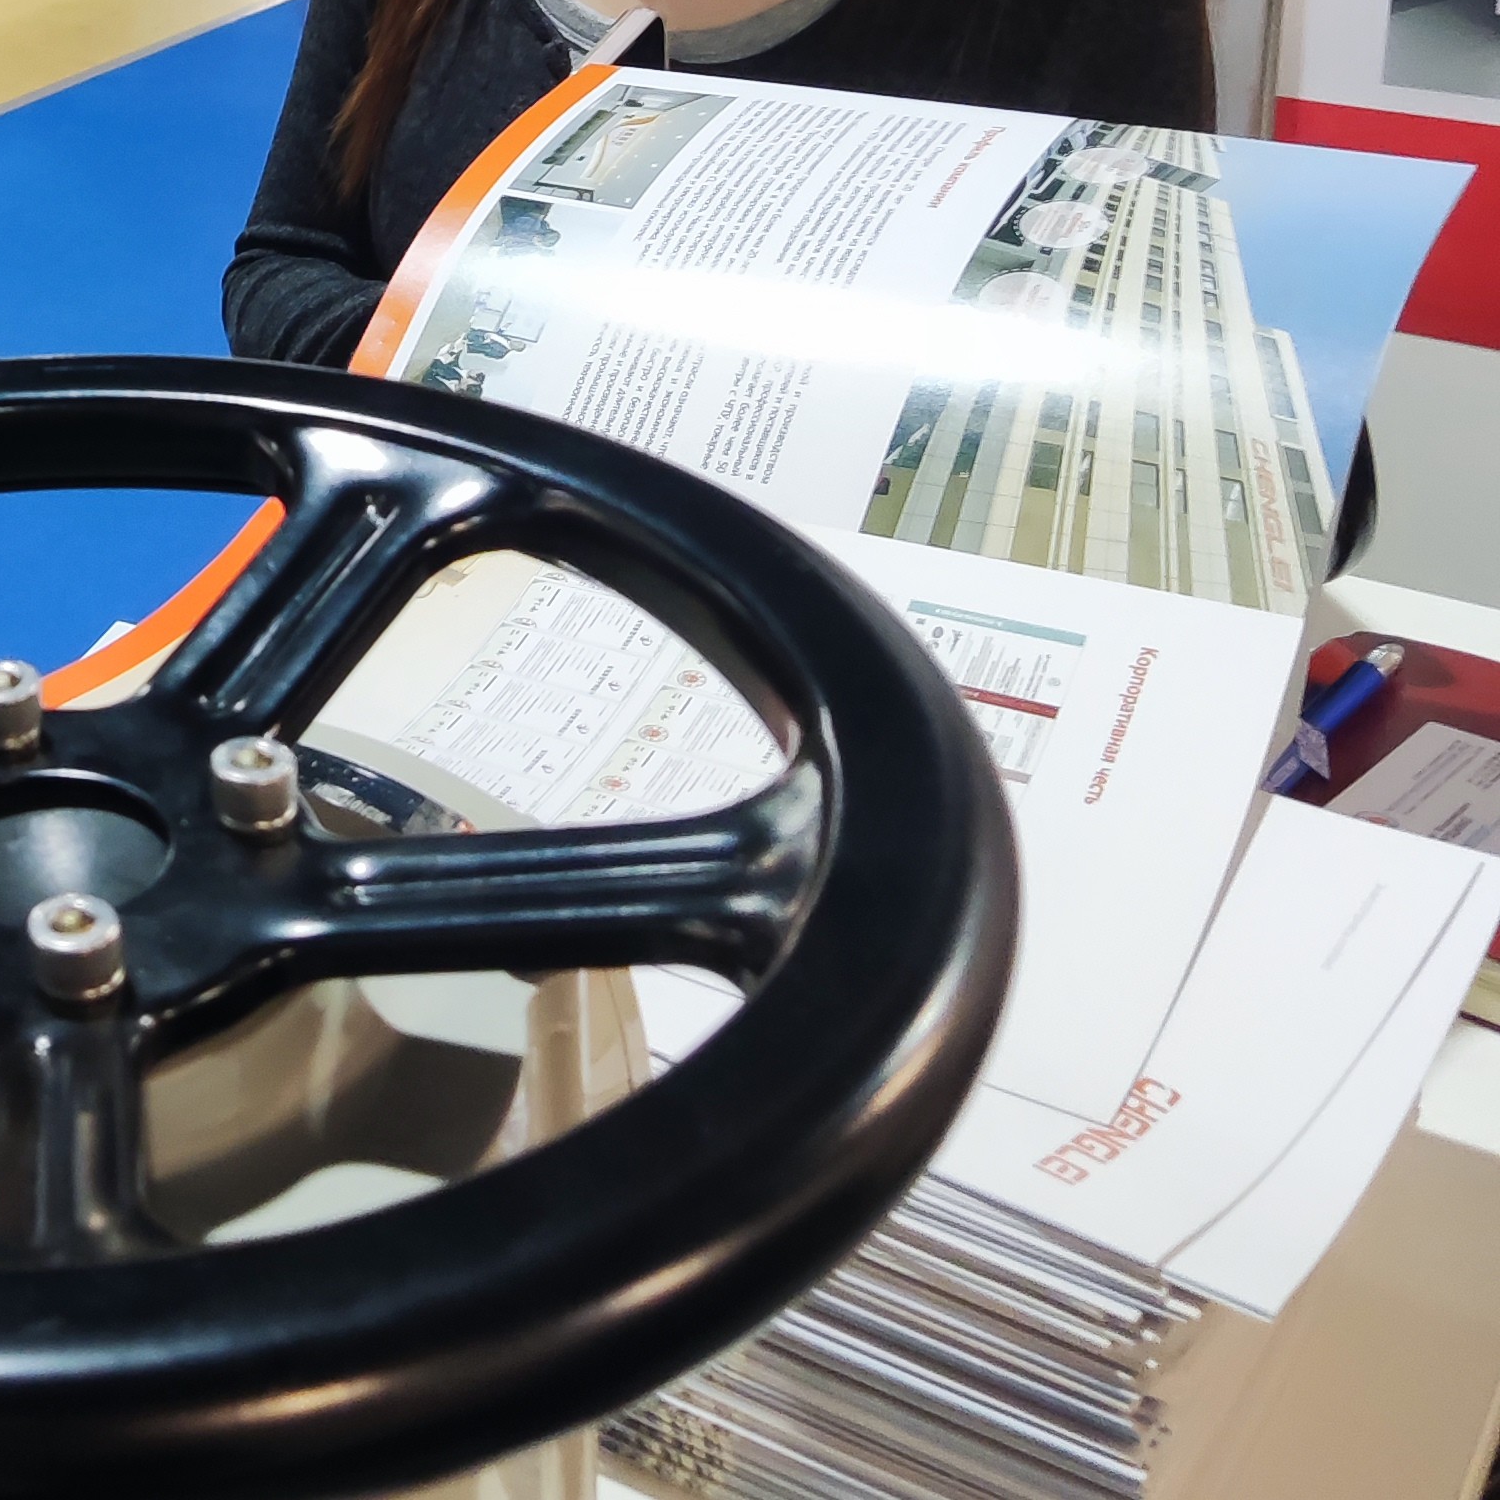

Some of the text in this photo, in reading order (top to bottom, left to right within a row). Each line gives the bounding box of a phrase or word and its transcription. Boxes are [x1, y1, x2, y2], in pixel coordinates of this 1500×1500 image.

[1082, 645, 1159, 806] Корпоративная честь
[1034, 1076, 1183, 1187] CHENGLEI
